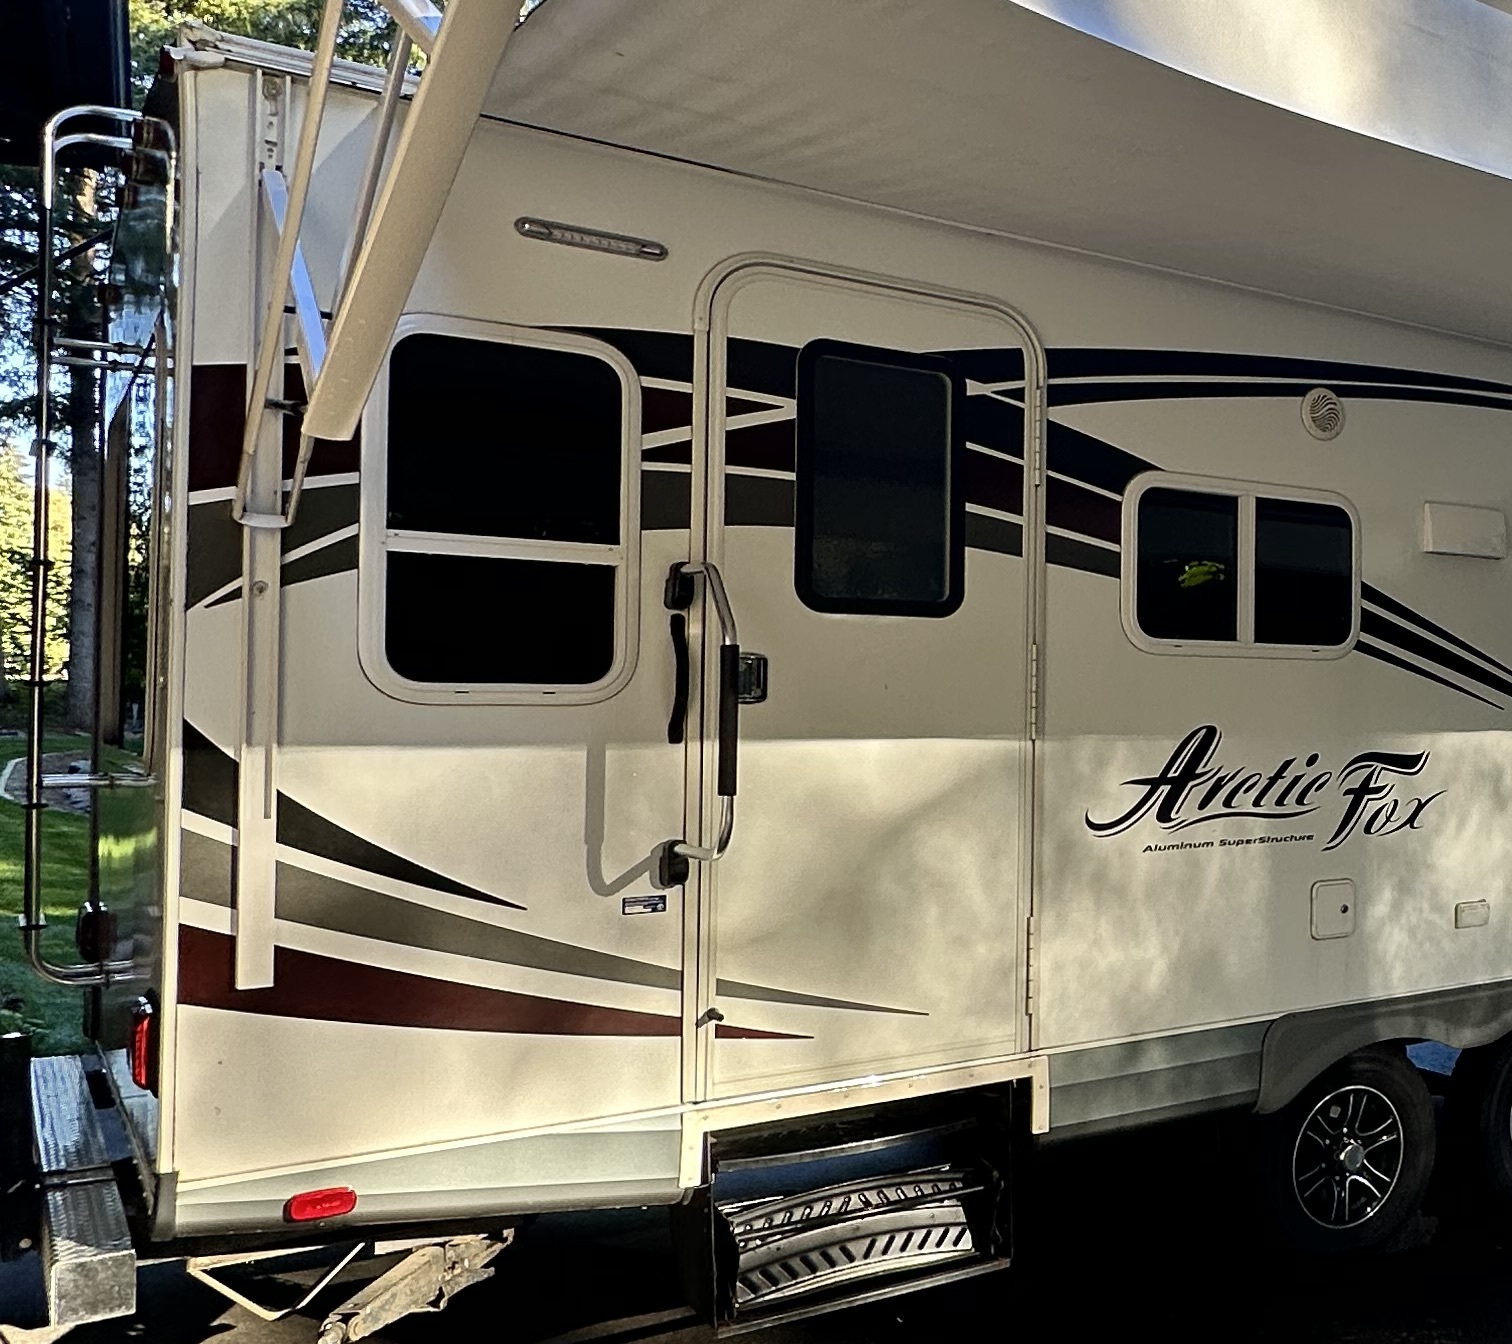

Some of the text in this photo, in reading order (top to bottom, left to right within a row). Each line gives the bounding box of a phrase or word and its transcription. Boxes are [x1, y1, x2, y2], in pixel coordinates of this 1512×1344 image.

[1085, 724, 1448, 852] Arctic Fox
[1142, 834, 1315, 853] Aluminum SuperStructure
